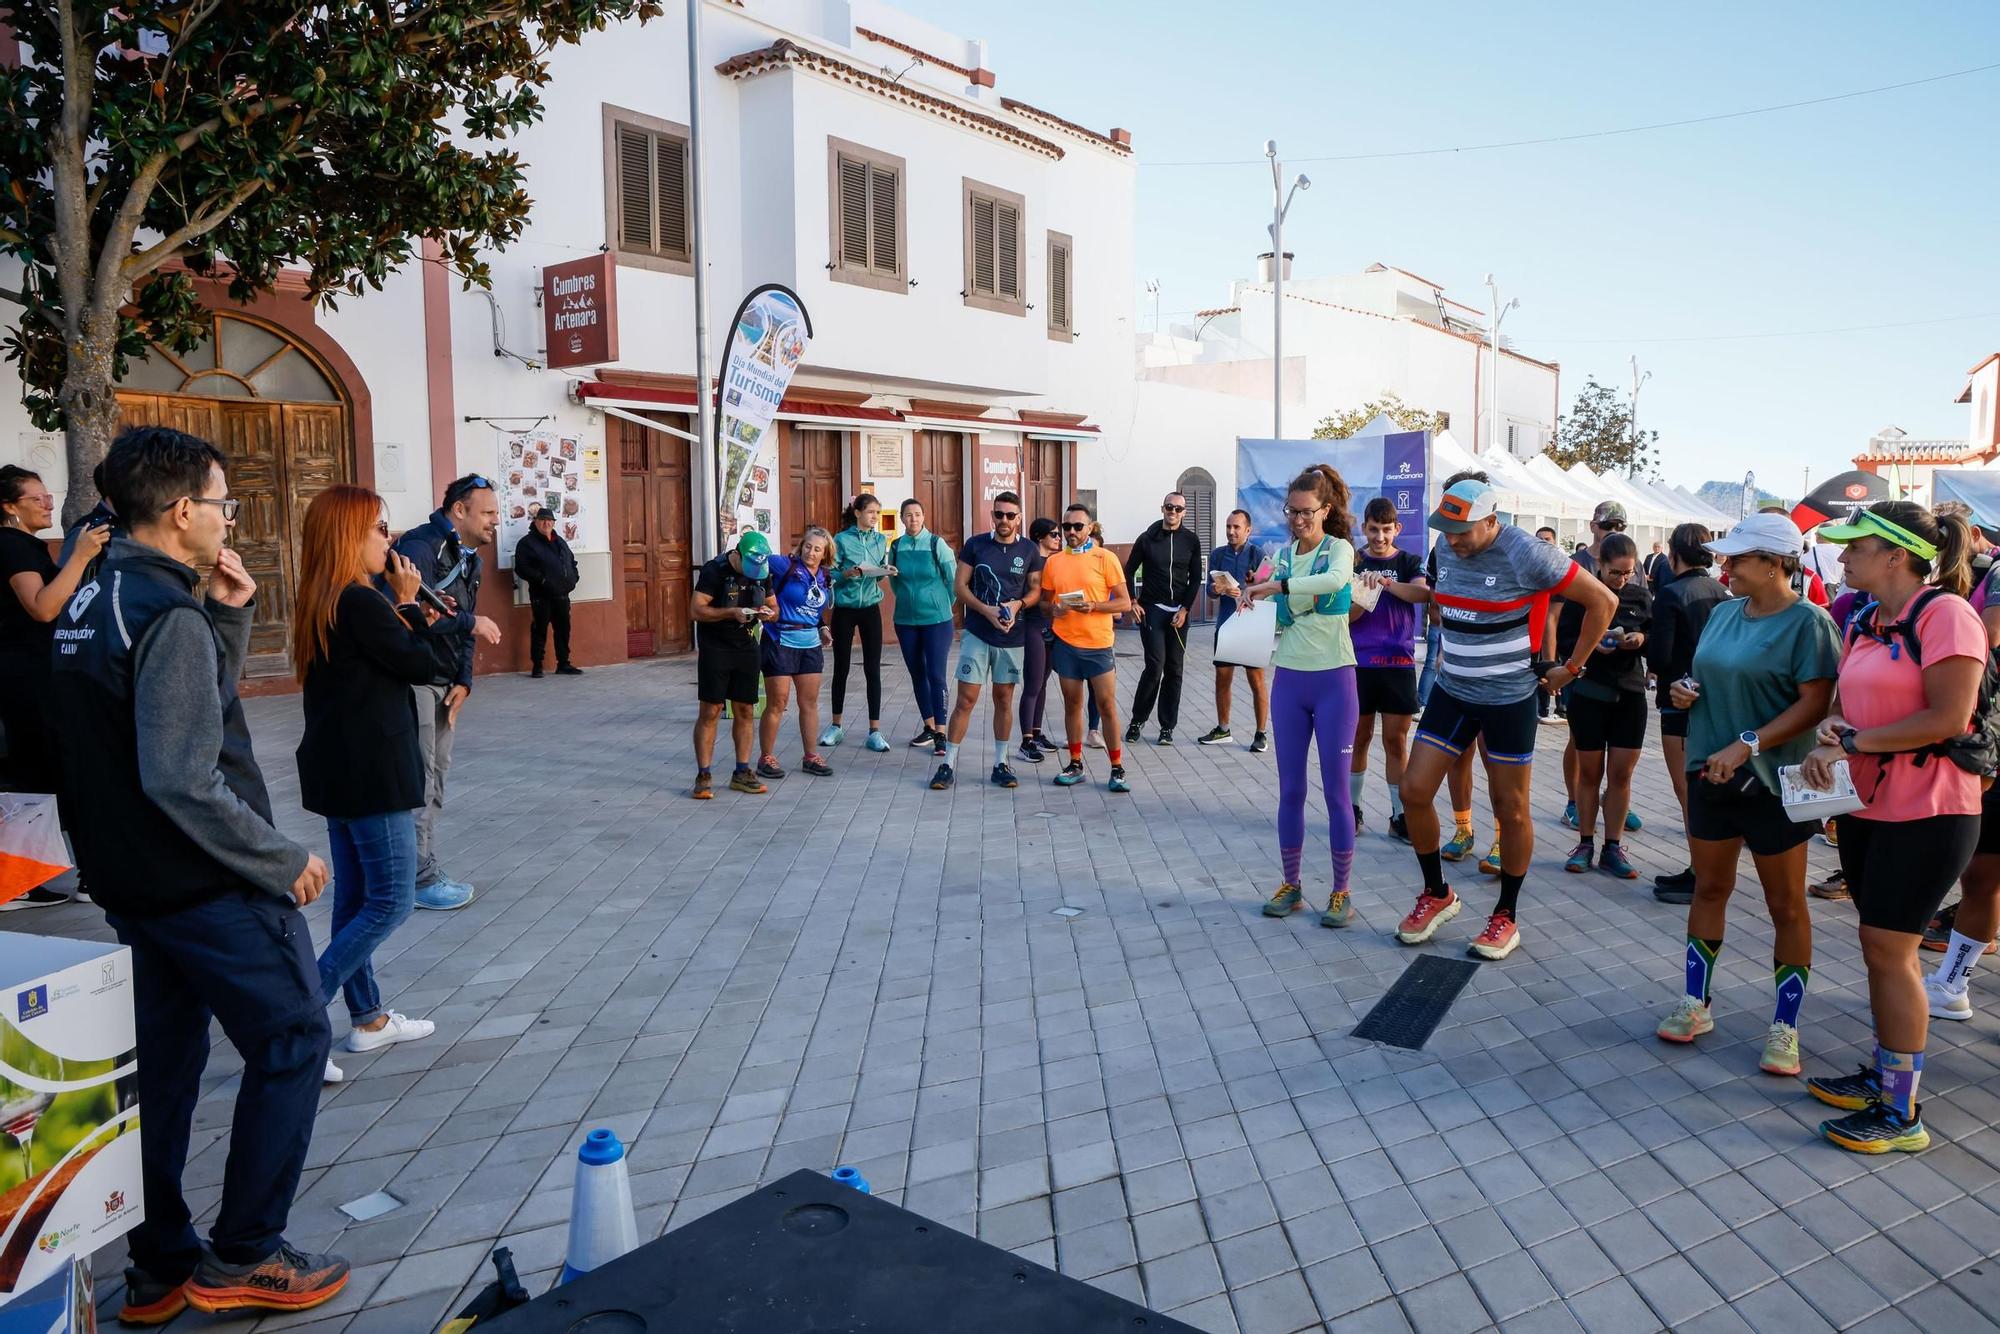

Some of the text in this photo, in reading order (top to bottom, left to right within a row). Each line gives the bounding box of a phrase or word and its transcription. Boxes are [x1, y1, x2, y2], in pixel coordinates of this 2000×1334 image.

[553, 274, 595, 297] Cumbres
[554, 309, 597, 331] Artenara
[746, 361, 775, 383] Mundial
[774, 376, 787, 388] del
[729, 365, 782, 406] Turismo
[984, 457, 1017, 475] Cumbres
[1442, 606, 1478, 621] RUNIZE
[60, 1223, 81, 1237] Norte
[248, 1274, 290, 1291] HOKA
